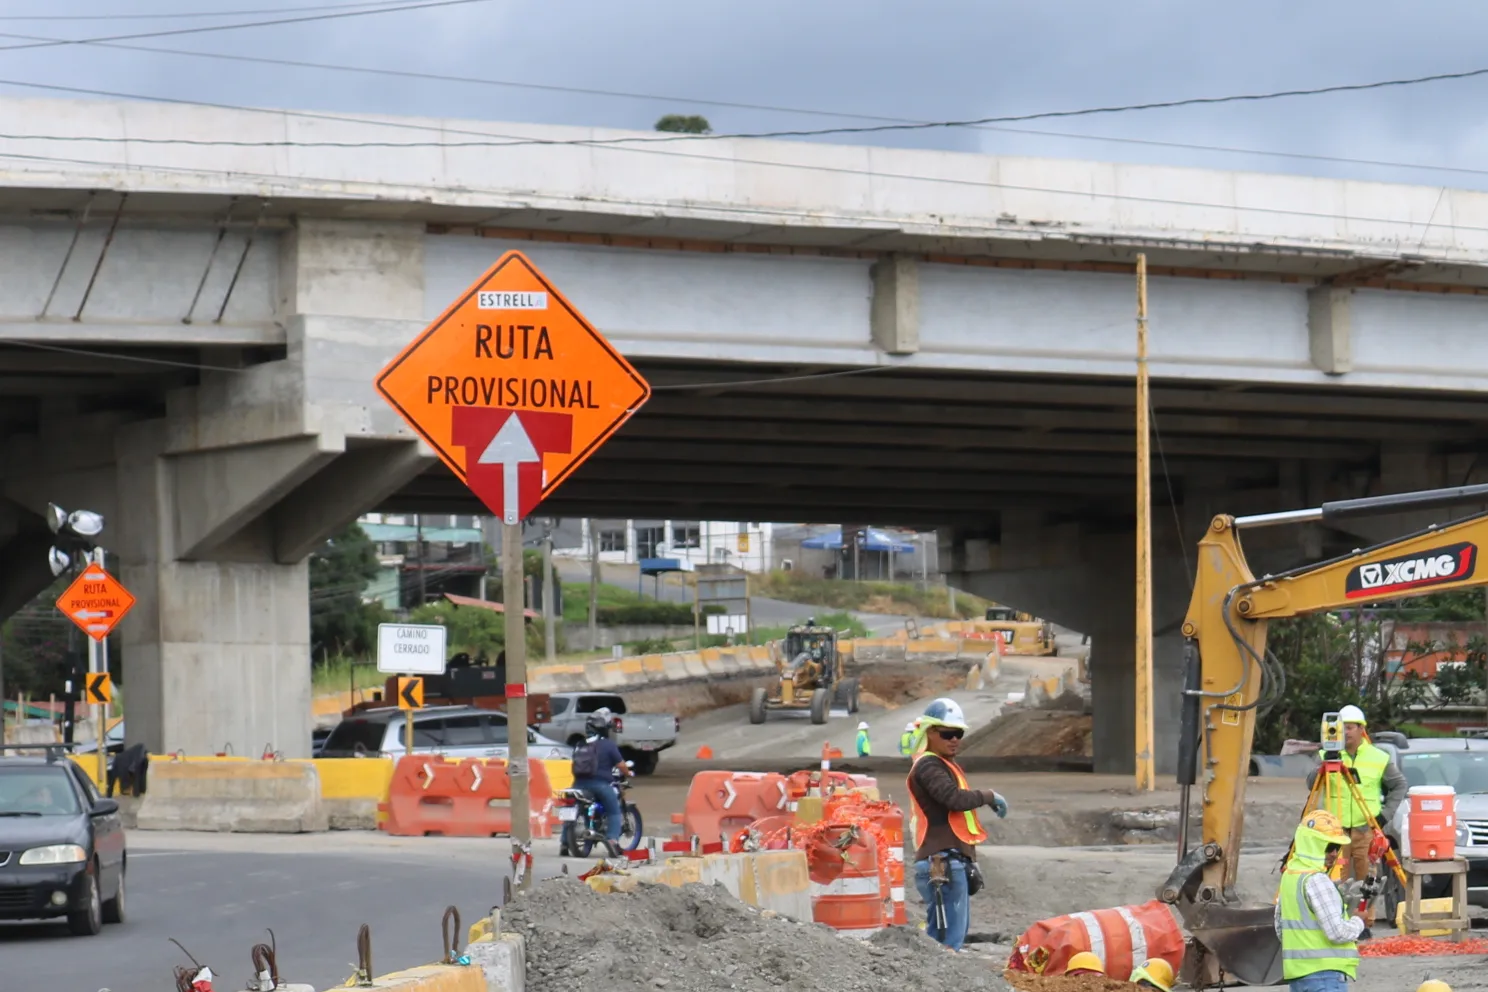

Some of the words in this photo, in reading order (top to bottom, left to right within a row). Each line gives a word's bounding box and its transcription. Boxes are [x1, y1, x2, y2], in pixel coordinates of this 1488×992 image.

[475, 324, 554, 361] RUTA
[426, 375, 600, 409] PROVISIONAL
[1384, 554, 1456, 585] XCMG
[83, 583, 107, 595] RUTA
[70, 598, 121, 609] PROVISIONAL
[396, 628, 428, 640] CAMINO
[393, 643, 431, 655] CERRADO
